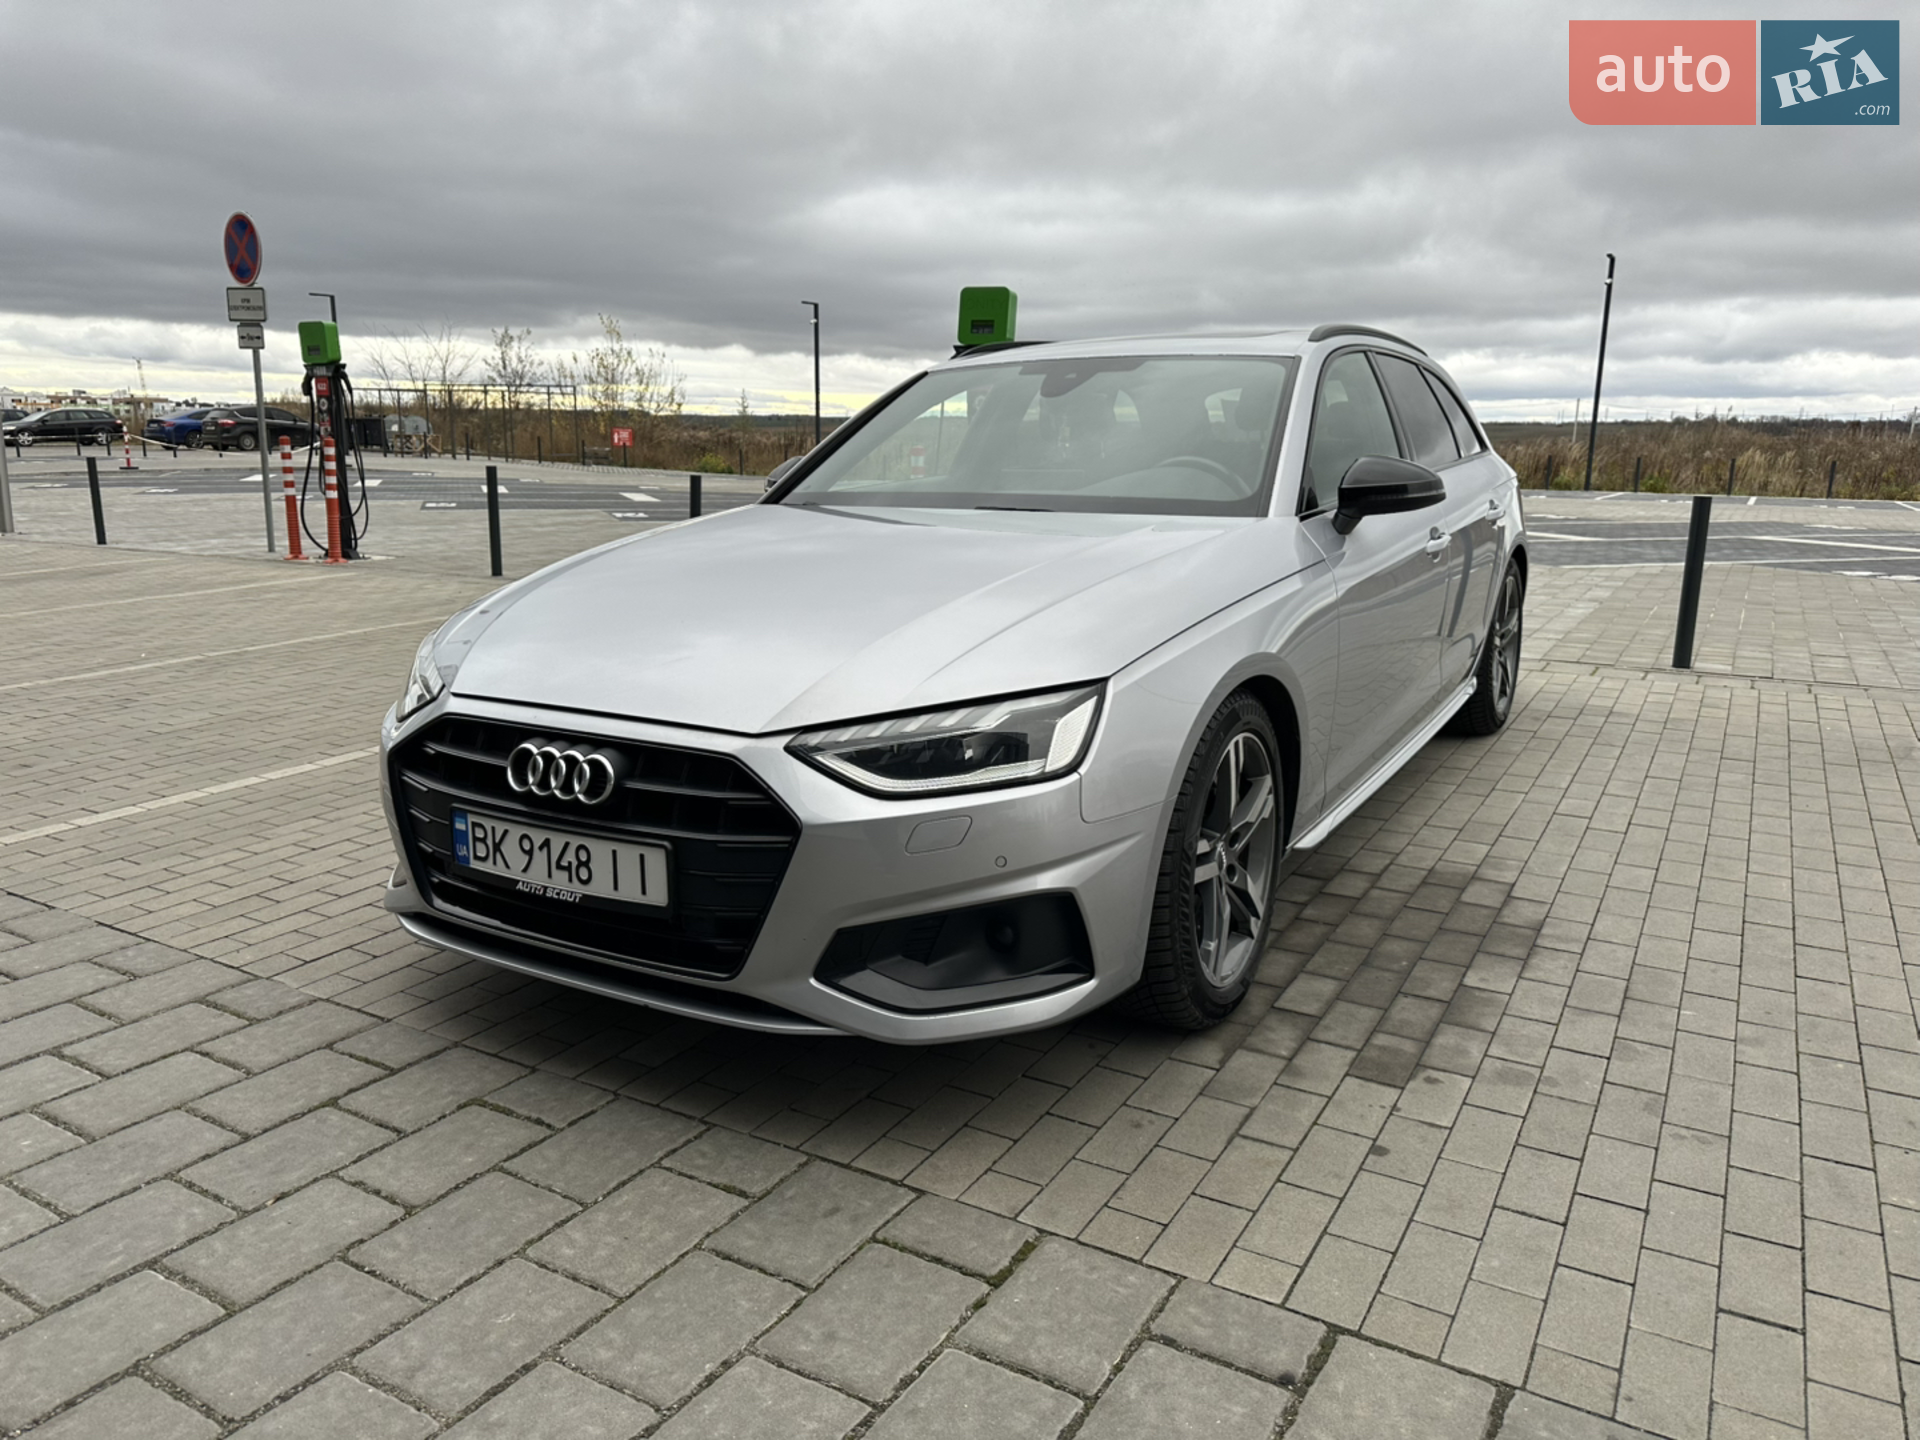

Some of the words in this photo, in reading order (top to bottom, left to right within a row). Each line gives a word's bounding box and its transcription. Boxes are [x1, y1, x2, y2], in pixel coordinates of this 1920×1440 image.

[456, 843, 469, 857] UA
[471, 820, 511, 870] BK
[518, 832, 593, 885] 9148
[515, 880, 544, 895] AUTO
[545, 887, 582, 903] SCOUT
